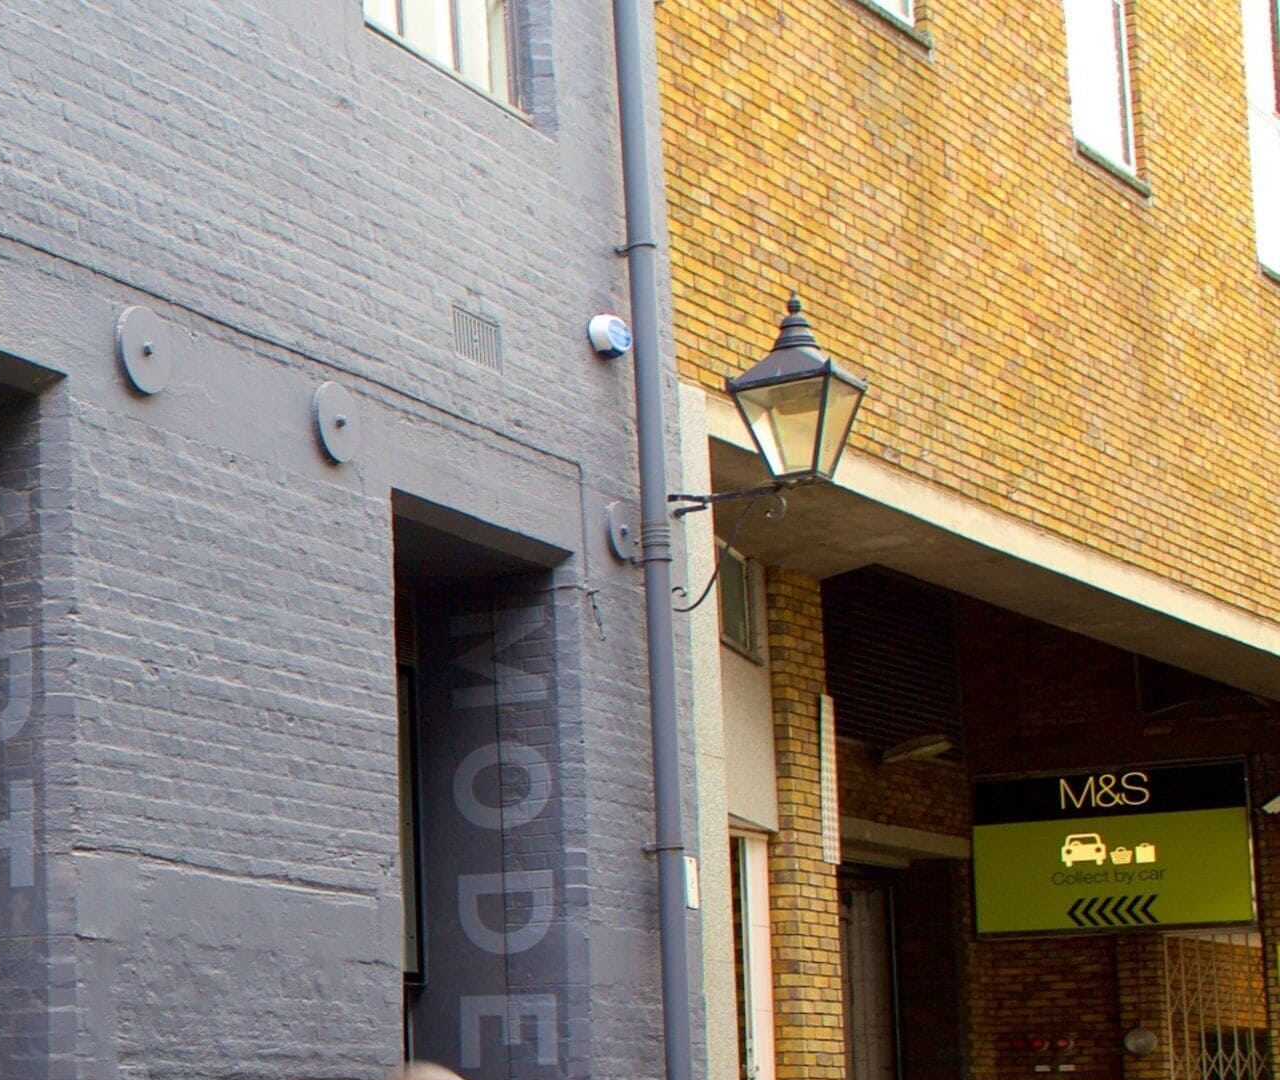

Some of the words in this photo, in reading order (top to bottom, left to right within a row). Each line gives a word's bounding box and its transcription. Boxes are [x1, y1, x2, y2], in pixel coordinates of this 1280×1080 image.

[1059, 771, 1151, 810] M&S
[1051, 870, 1109, 886] Collect
[1114, 869, 1134, 885] by
[1139, 868, 1166, 882] car
